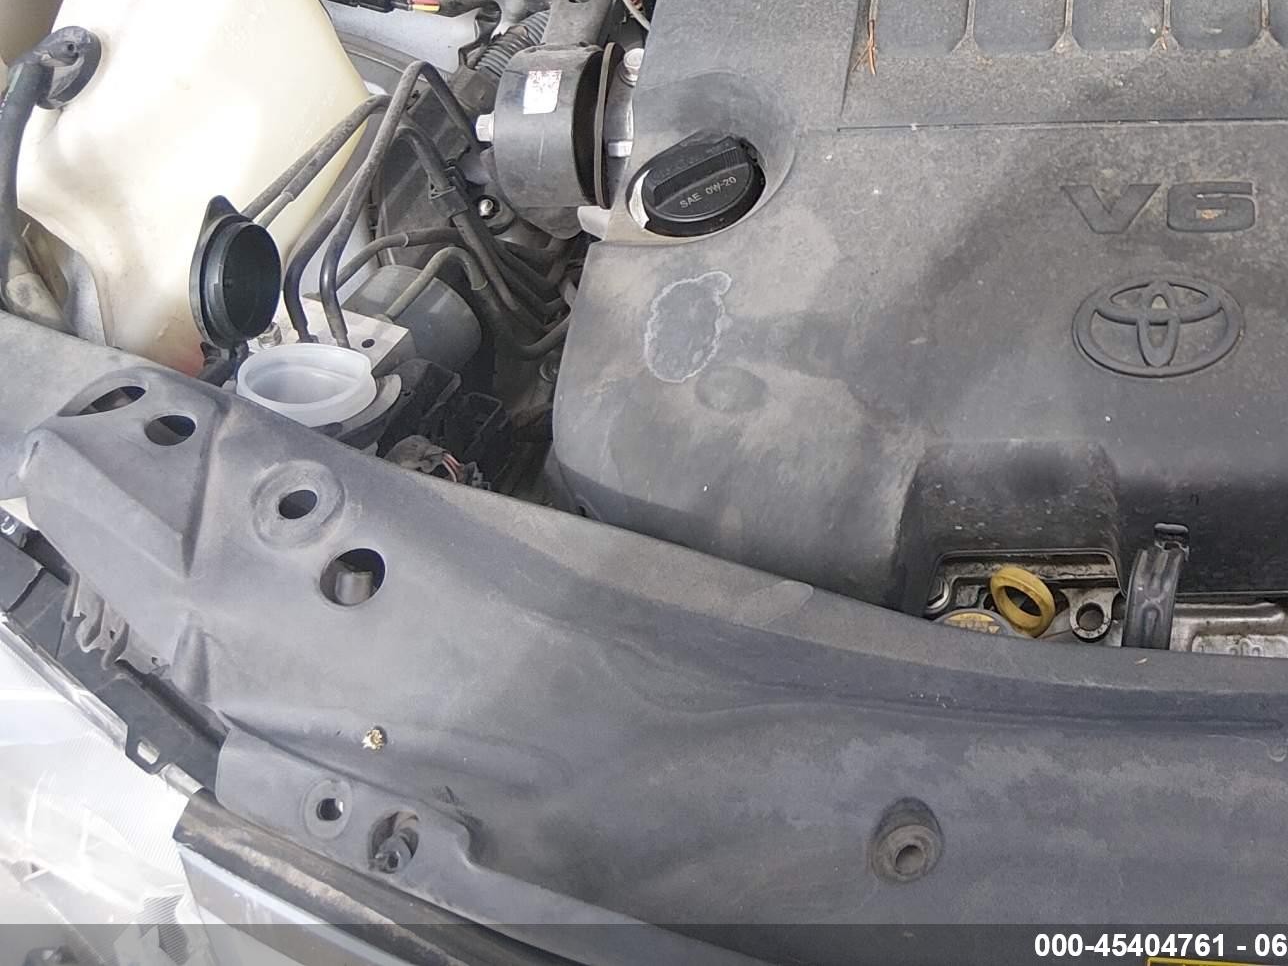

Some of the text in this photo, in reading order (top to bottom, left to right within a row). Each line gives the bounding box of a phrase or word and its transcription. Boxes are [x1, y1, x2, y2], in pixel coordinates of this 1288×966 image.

[680, 176, 737, 208] SAE 0W-20
[1060, 181, 1257, 235] V6
